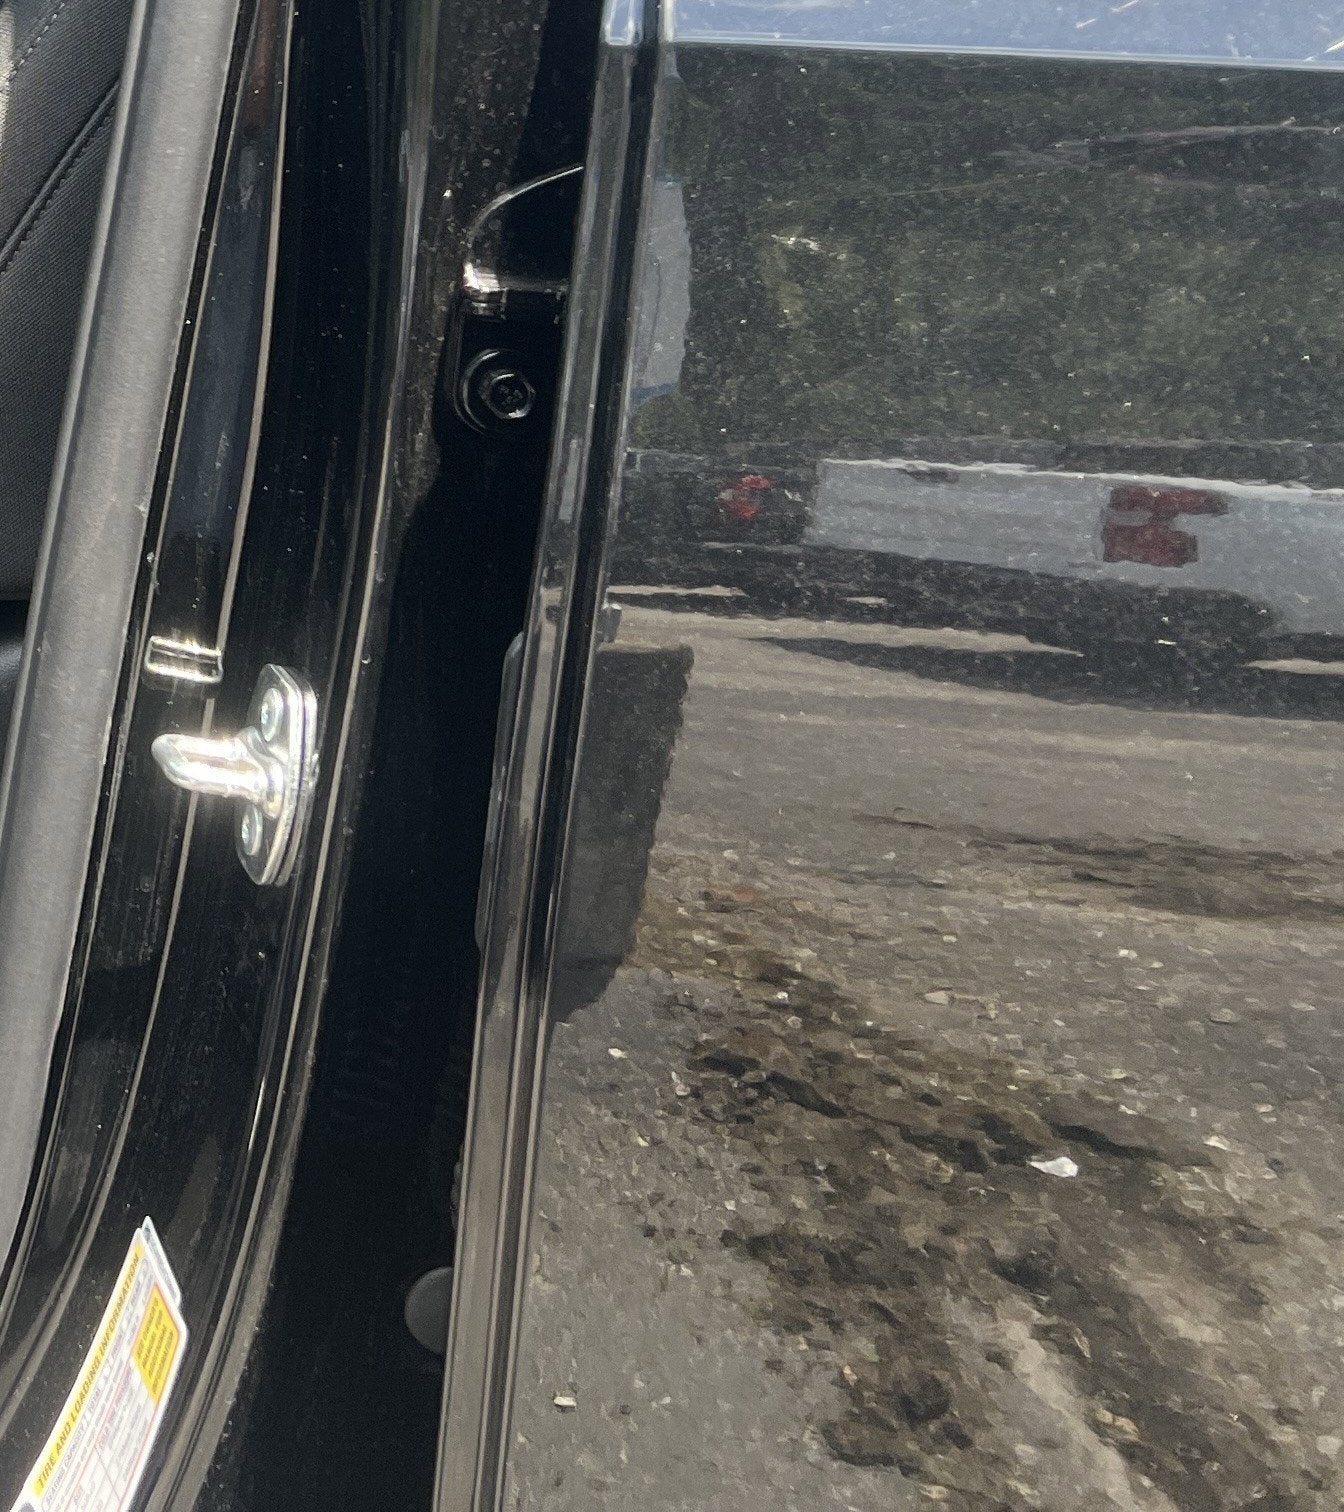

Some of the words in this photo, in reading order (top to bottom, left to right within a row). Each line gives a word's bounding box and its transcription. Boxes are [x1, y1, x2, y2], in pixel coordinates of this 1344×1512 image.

[37, 1452, 56, 1488] TIRE
[54, 1418, 71, 1457] AND
[69, 1353, 101, 1423] LOADING
[98, 1253, 140, 1358] INFORMATION
